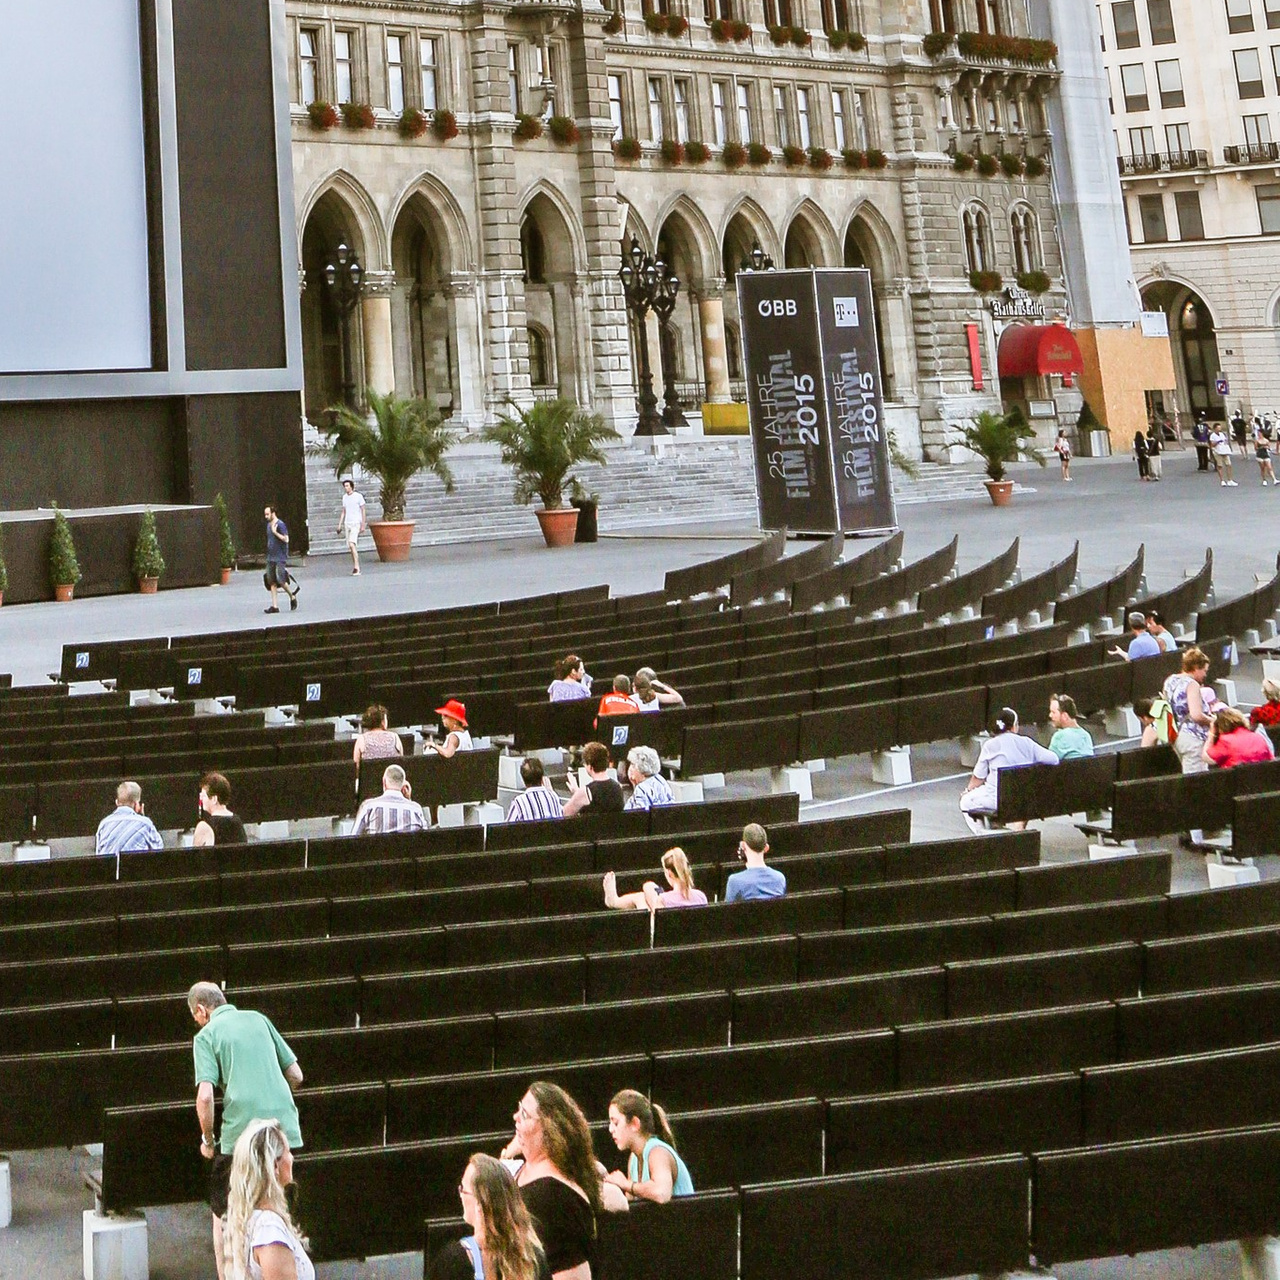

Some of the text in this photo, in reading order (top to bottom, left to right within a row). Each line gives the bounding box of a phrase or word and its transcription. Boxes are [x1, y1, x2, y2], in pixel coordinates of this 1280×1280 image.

[757, 373, 786, 478] 25 JAHRE
[769, 349, 810, 498] FILM FESTIVAL
[794, 374, 820, 445] 2015
[832, 372, 853, 443] JAHRE
[841, 347, 875, 497] FILM FESTIVAL
[859, 372, 879, 442] 2015
[843, 450, 857, 478] 25
